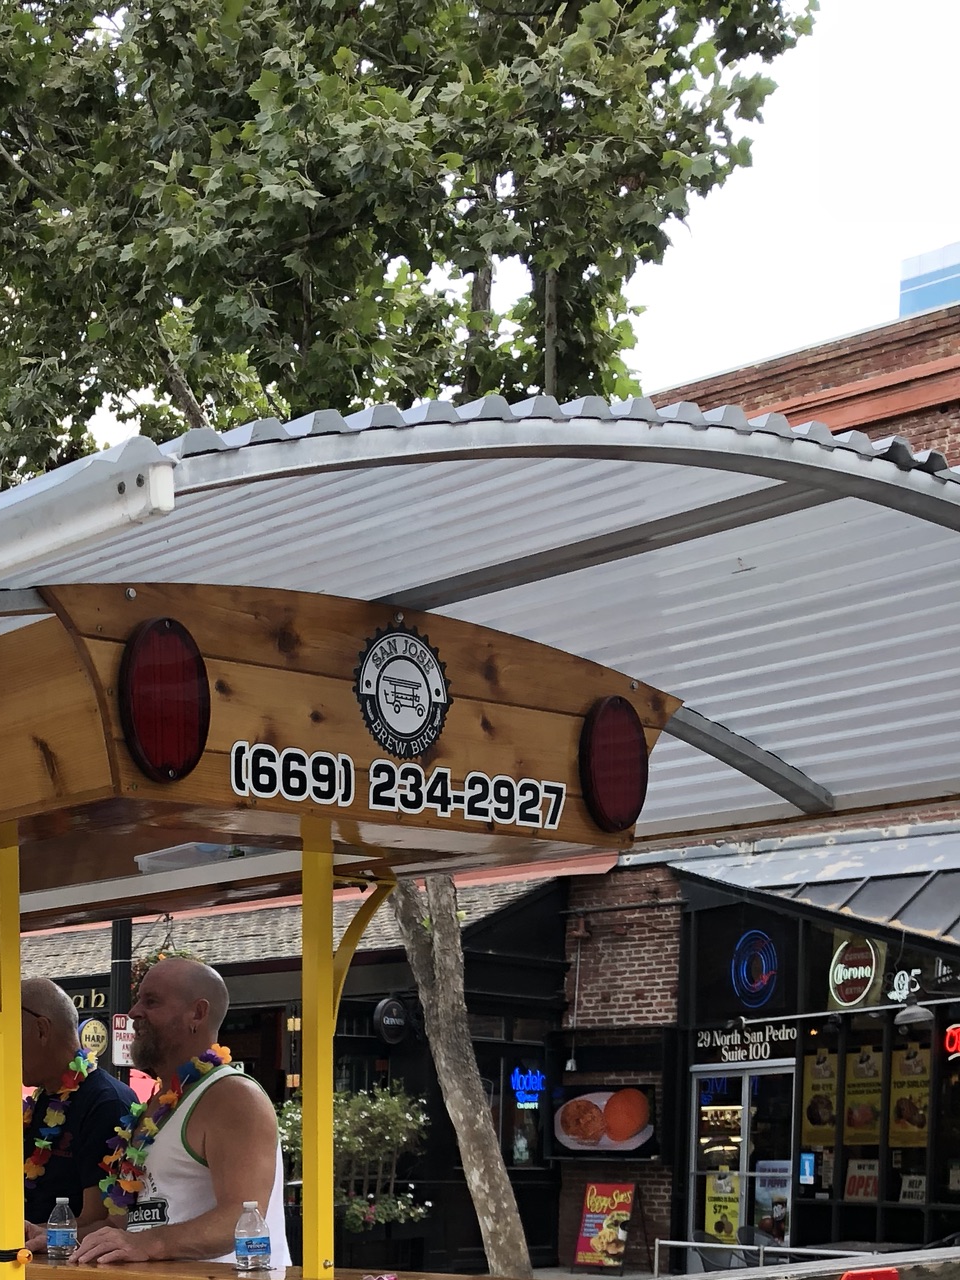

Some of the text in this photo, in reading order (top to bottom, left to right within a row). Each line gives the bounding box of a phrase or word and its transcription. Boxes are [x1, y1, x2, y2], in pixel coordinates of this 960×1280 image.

[371, 638, 435, 675] SAN JOSE
[371, 718, 438, 755] BREW BIKE
[234, 744, 564, 827] (669) 234-2927
[834, 963, 872, 985] Corona
[115, 1016, 126, 1029] NO
[84, 1034, 106, 1044] HARP
[697, 1023, 797, 1048] 29 North San Pedro
[122, 1043, 130, 1051] AN
[721, 1042, 771, 1062] Suite 100
[907, 1179, 923, 1189] HELP
[128, 1206, 161, 1223] neken
